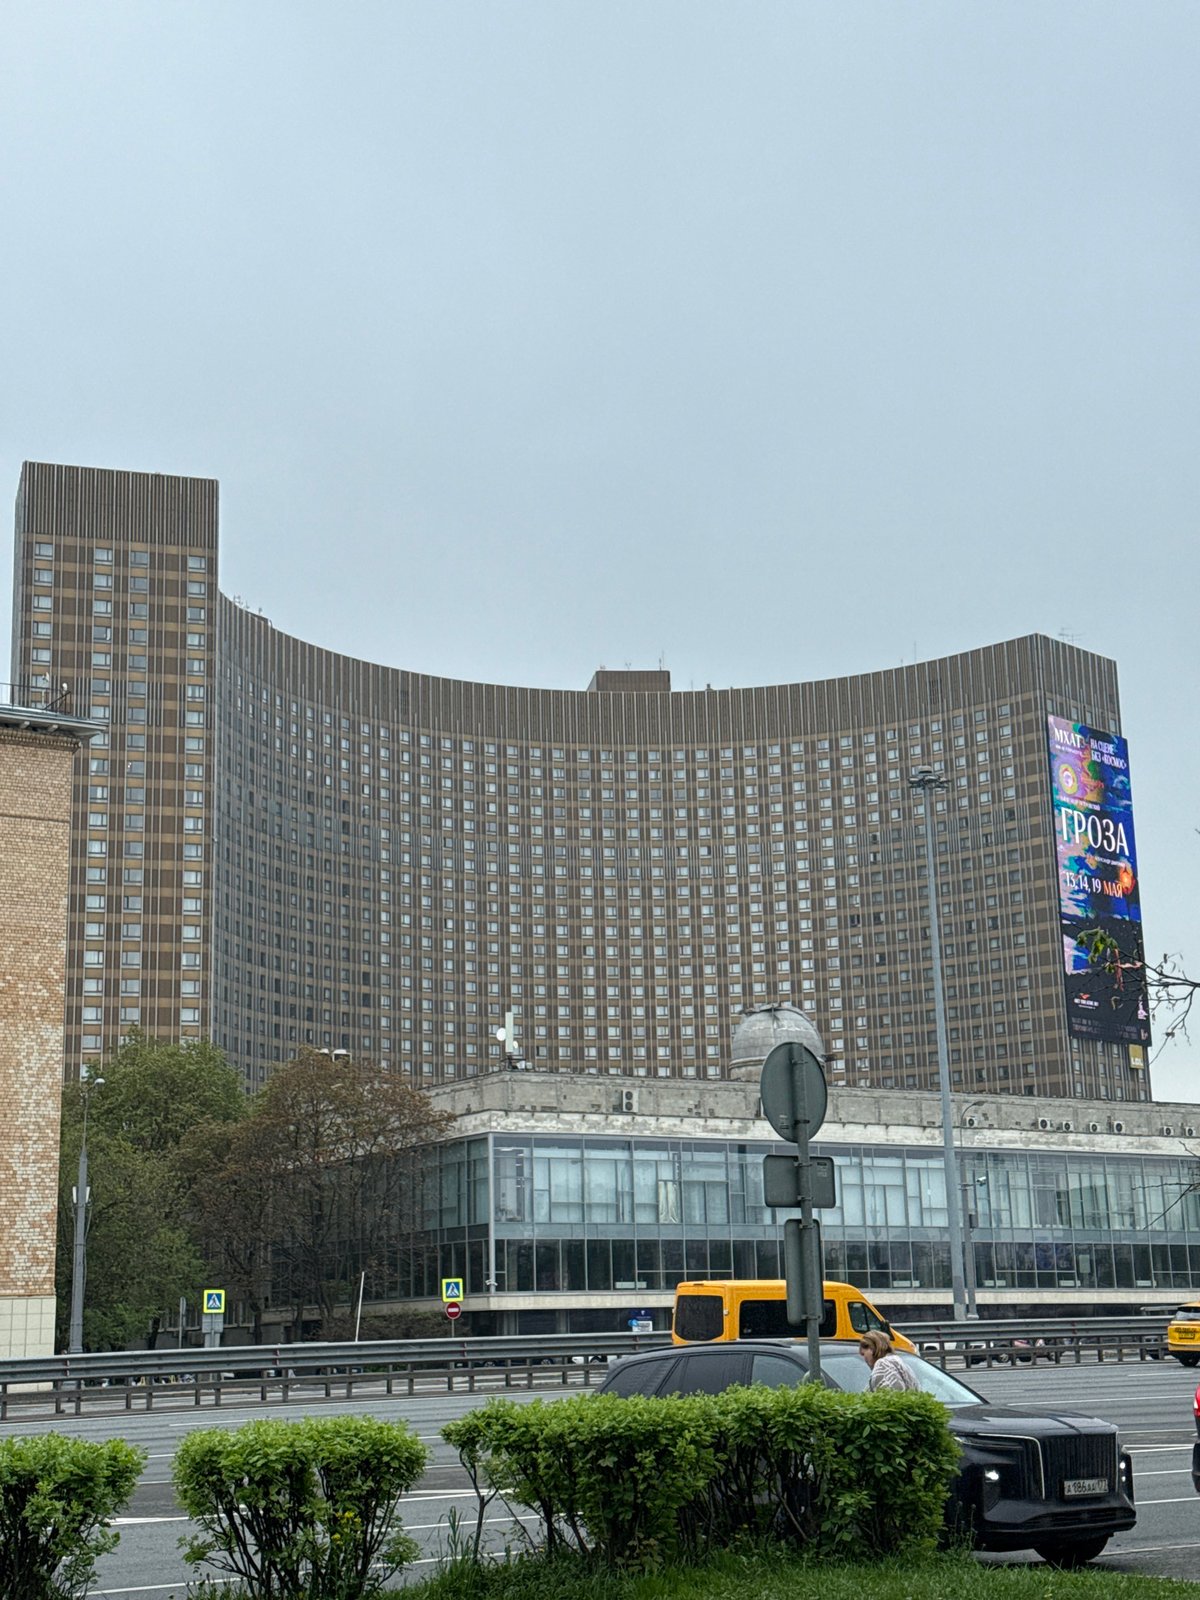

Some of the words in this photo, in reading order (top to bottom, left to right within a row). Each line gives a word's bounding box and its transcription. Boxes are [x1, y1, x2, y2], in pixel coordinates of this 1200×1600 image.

[1054, 727, 1082, 748] МХАТ
[1090, 737, 1098, 749] НА
[1061, 807, 1130, 857] ГРОЗА
[1091, 877, 1102, 894] 19
[1103, 880, 1123, 899] МАЯ
